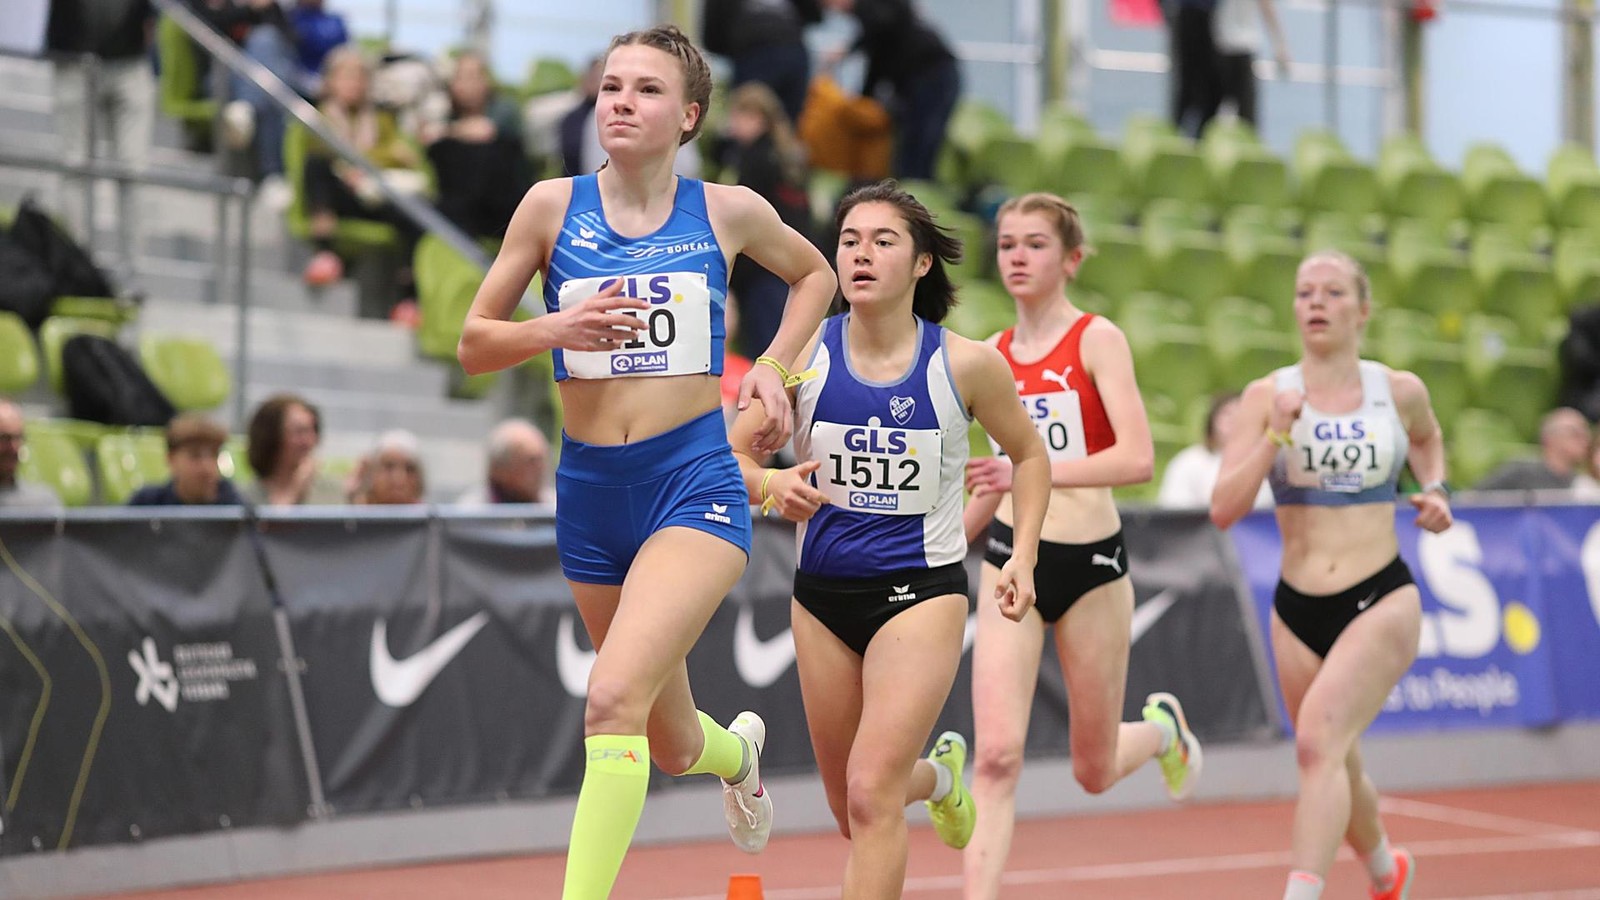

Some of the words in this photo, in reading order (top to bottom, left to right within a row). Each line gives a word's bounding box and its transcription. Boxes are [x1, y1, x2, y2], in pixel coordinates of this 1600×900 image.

[571, 239, 598, 250] erima
[667, 242, 710, 254] BOREAS
[634, 355, 666, 366] PLAN
[1302, 444, 1379, 472] 1491
[829, 454, 921, 491] 1512
[869, 495, 897, 504] PLAN
[705, 512, 731, 524] erima
[889, 592, 916, 603] erima
